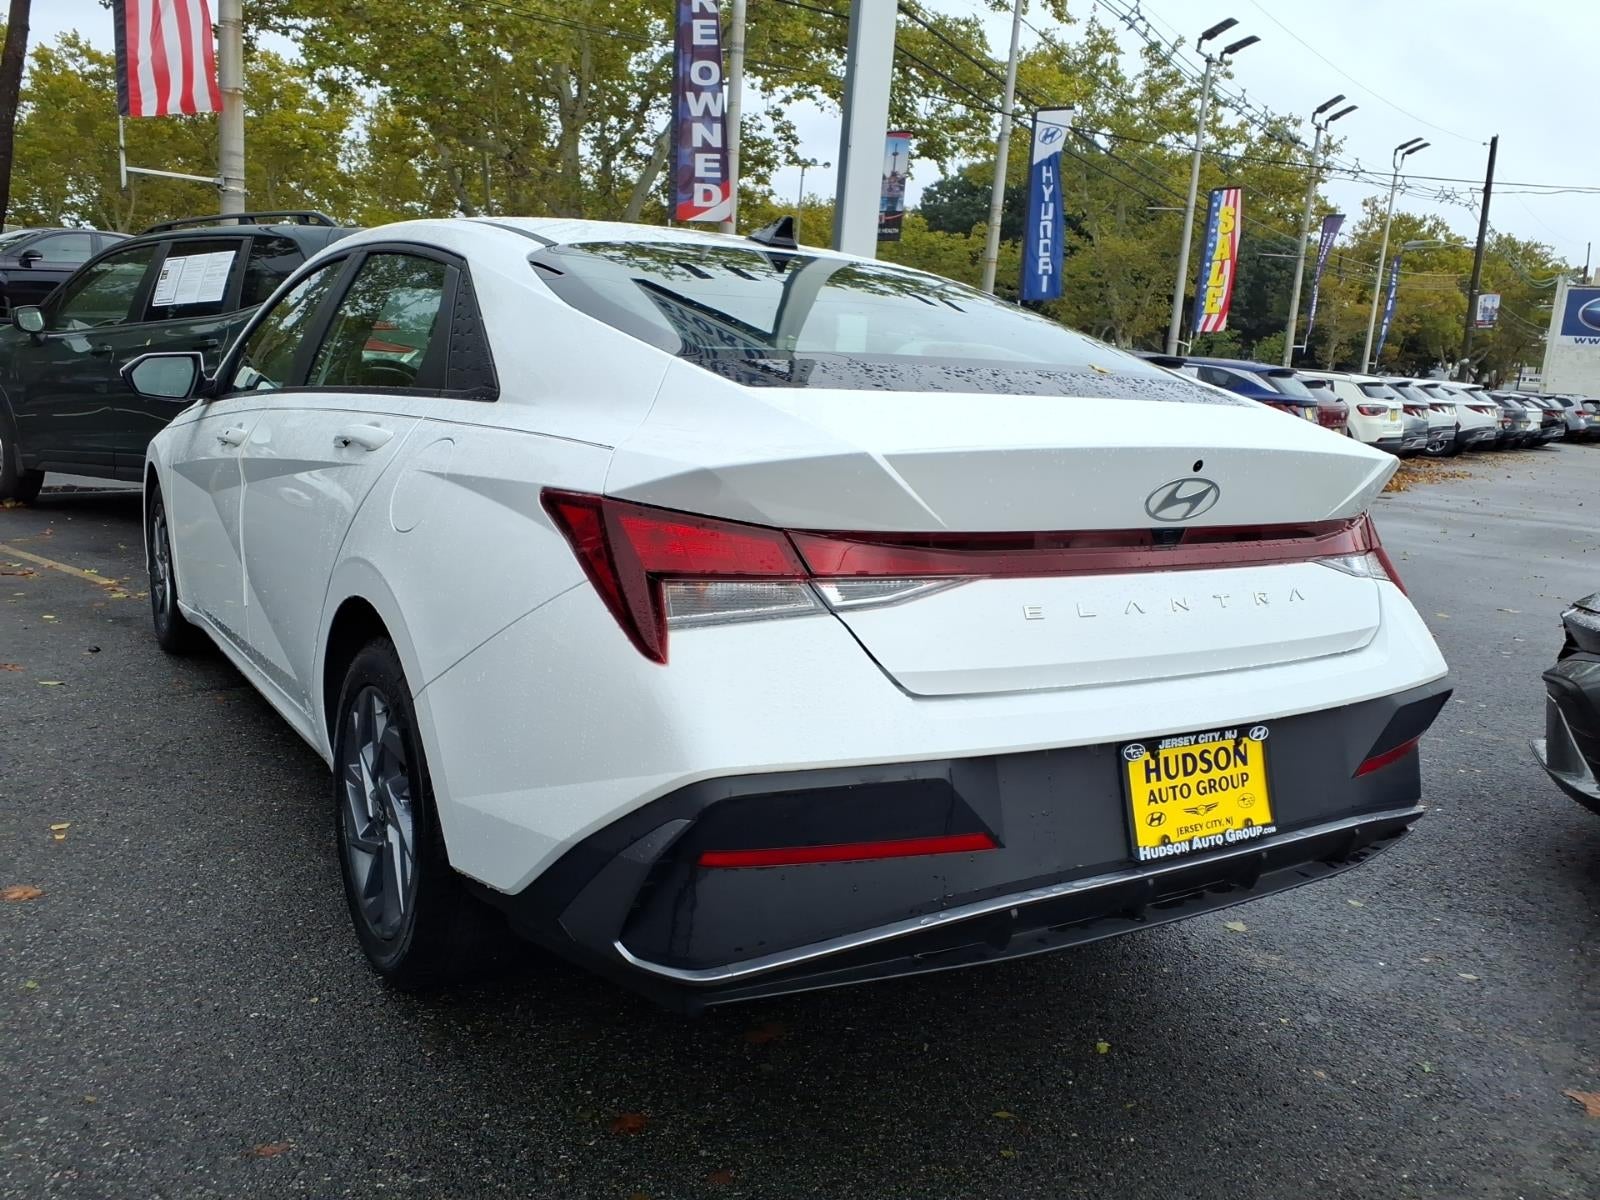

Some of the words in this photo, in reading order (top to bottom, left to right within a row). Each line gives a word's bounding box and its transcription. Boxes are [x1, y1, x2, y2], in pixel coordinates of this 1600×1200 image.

[1038, 166, 1052, 293] HYUNDAI
[1204, 206, 1235, 315] SALE
[1023, 587, 1304, 620] ELANTRA
[1158, 735, 1196, 750] JERSEY
[1198, 731, 1223, 743] CITY,
[1225, 729, 1238, 740] NJ
[1144, 743, 1248, 784] HUDSON
[1147, 783, 1191, 806] AUTO
[1196, 772, 1249, 796] GROUP
[1176, 823, 1204, 837] JERSEY
[1225, 816, 1234, 827] NJ
[1139, 842, 1190, 861] HUDSON
[1192, 834, 1224, 850] AUTO
